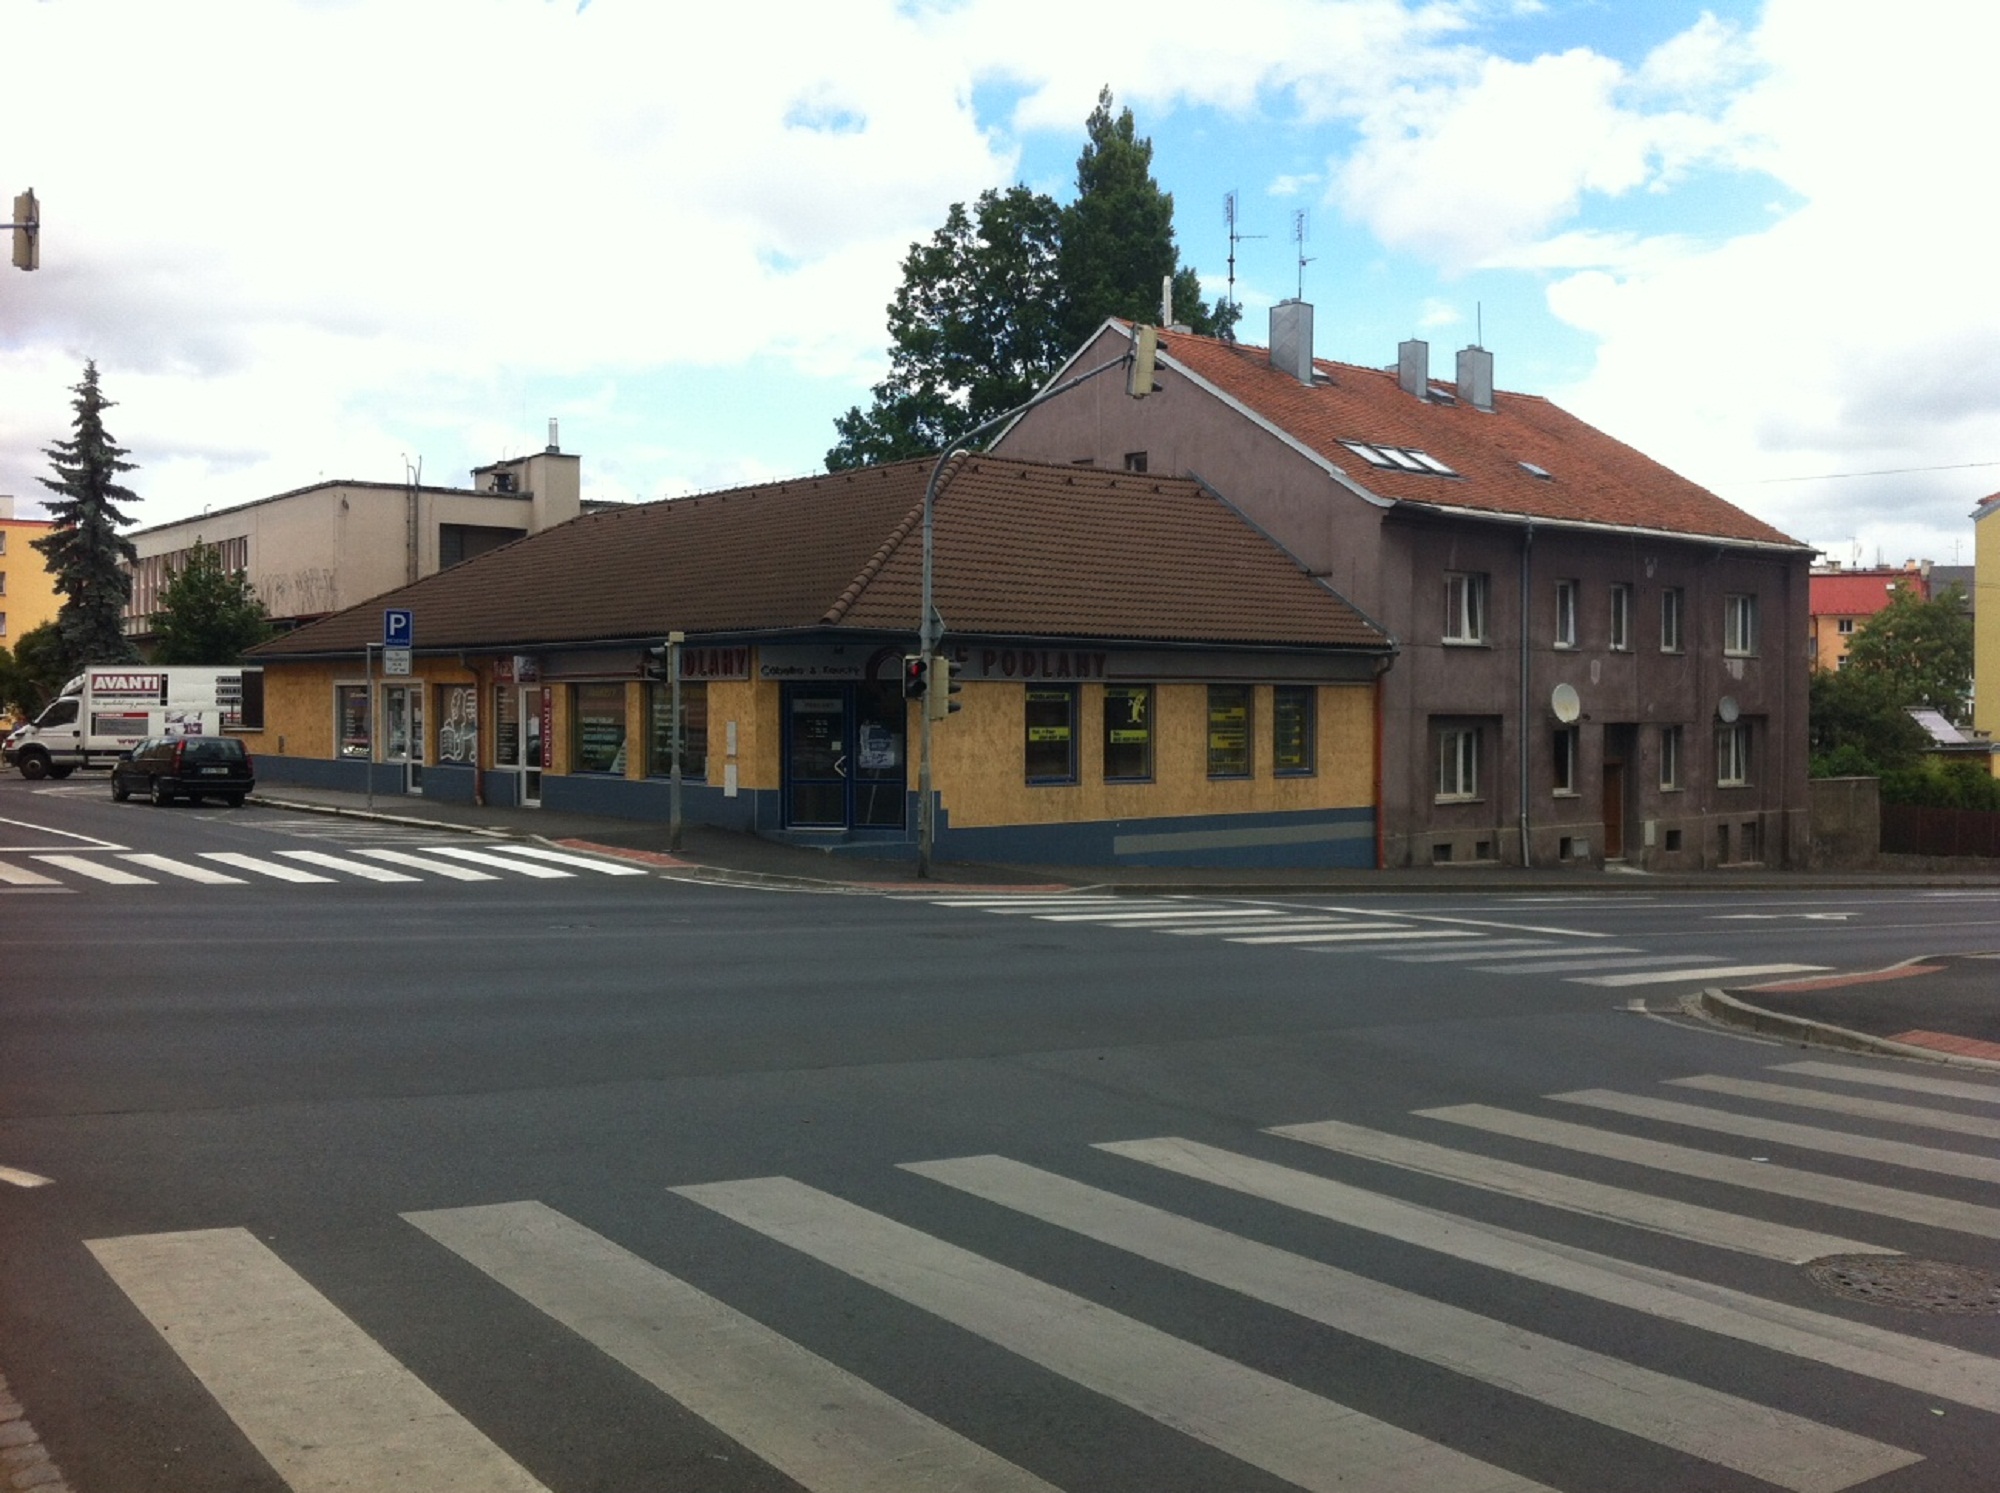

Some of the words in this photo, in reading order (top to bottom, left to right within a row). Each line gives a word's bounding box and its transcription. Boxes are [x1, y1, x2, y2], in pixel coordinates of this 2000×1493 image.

[389, 613, 407, 636] P
[684, 648, 747, 676] DLAHY
[982, 648, 1106, 677] PODLAHY
[93, 676, 158, 690] AVANTI
